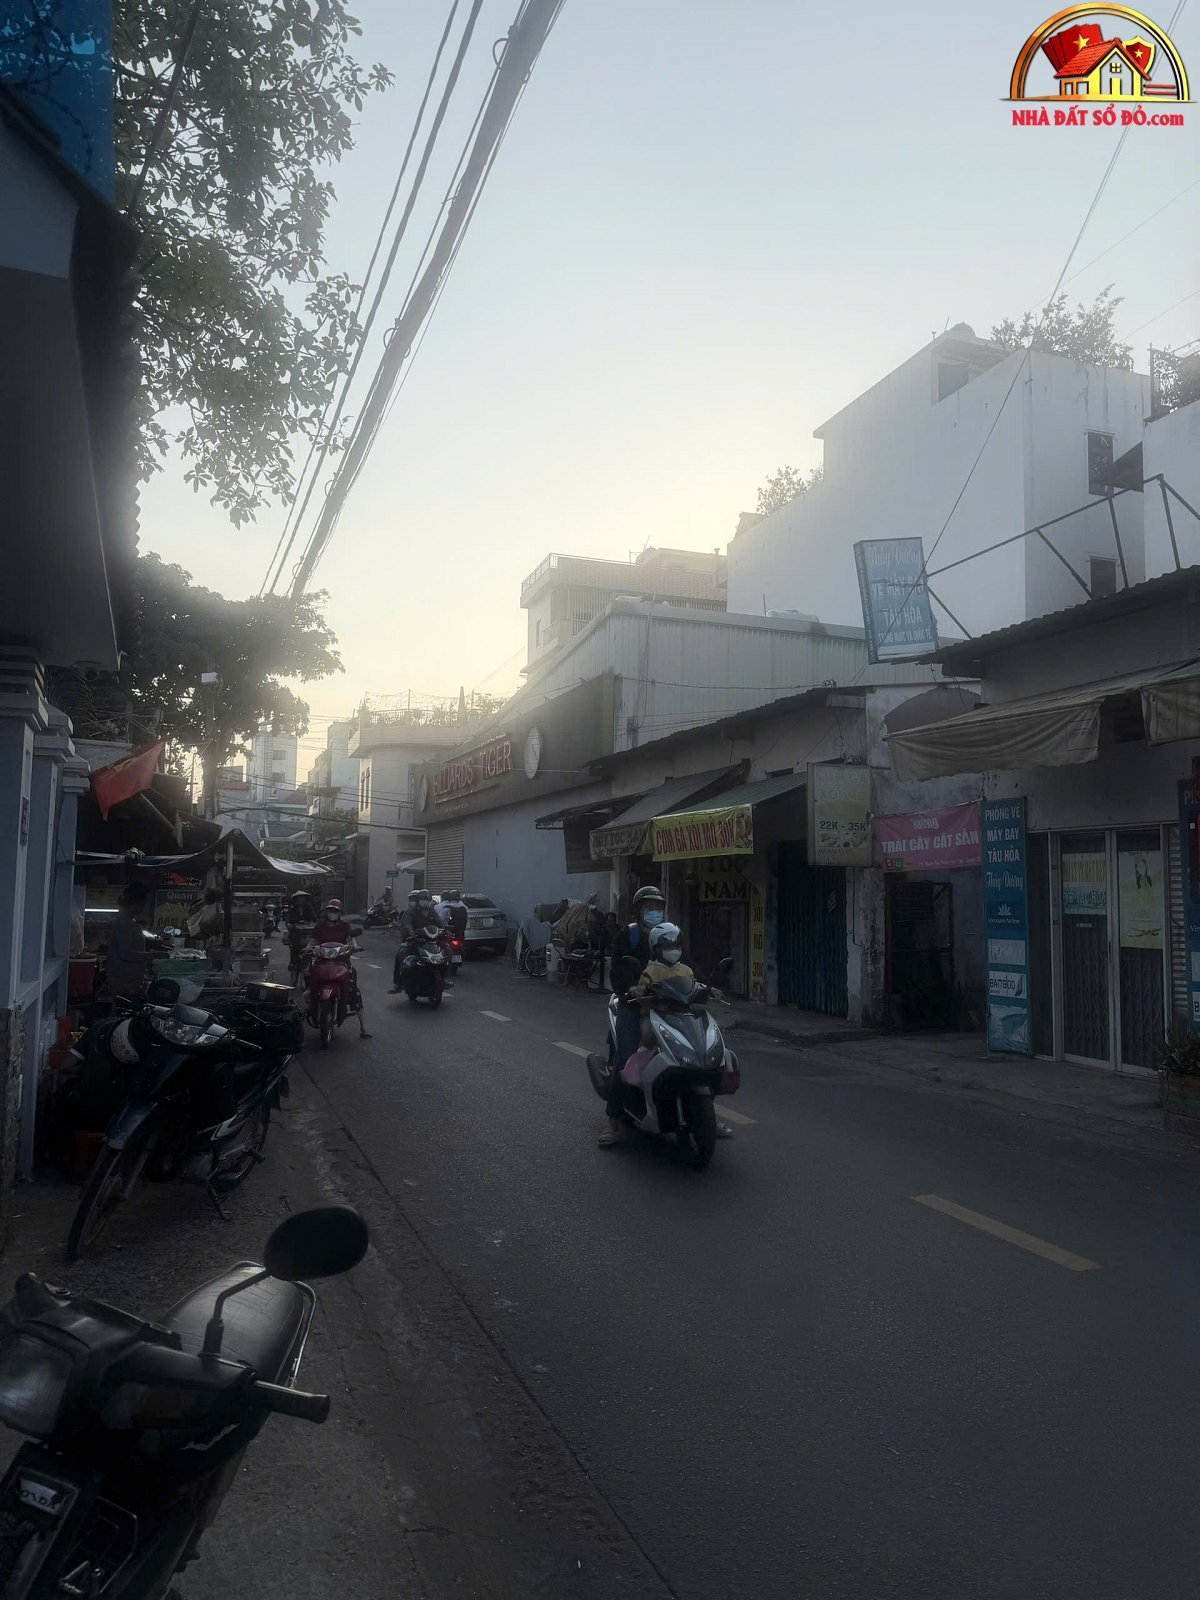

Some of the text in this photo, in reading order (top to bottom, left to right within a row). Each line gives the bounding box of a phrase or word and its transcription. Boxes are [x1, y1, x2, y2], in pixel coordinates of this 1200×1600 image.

[480, 740, 511, 780] TIGER
[985, 802, 1021, 821] PHÒNG VÉ
[819, 820, 838, 831] 22K
[848, 821, 867, 832] 35K
[987, 826, 1020, 842] MÁY BAY
[988, 847, 1002, 863] TÀU
[1004, 844, 1020, 862] HỎA
[703, 880, 747, 900] NAM
